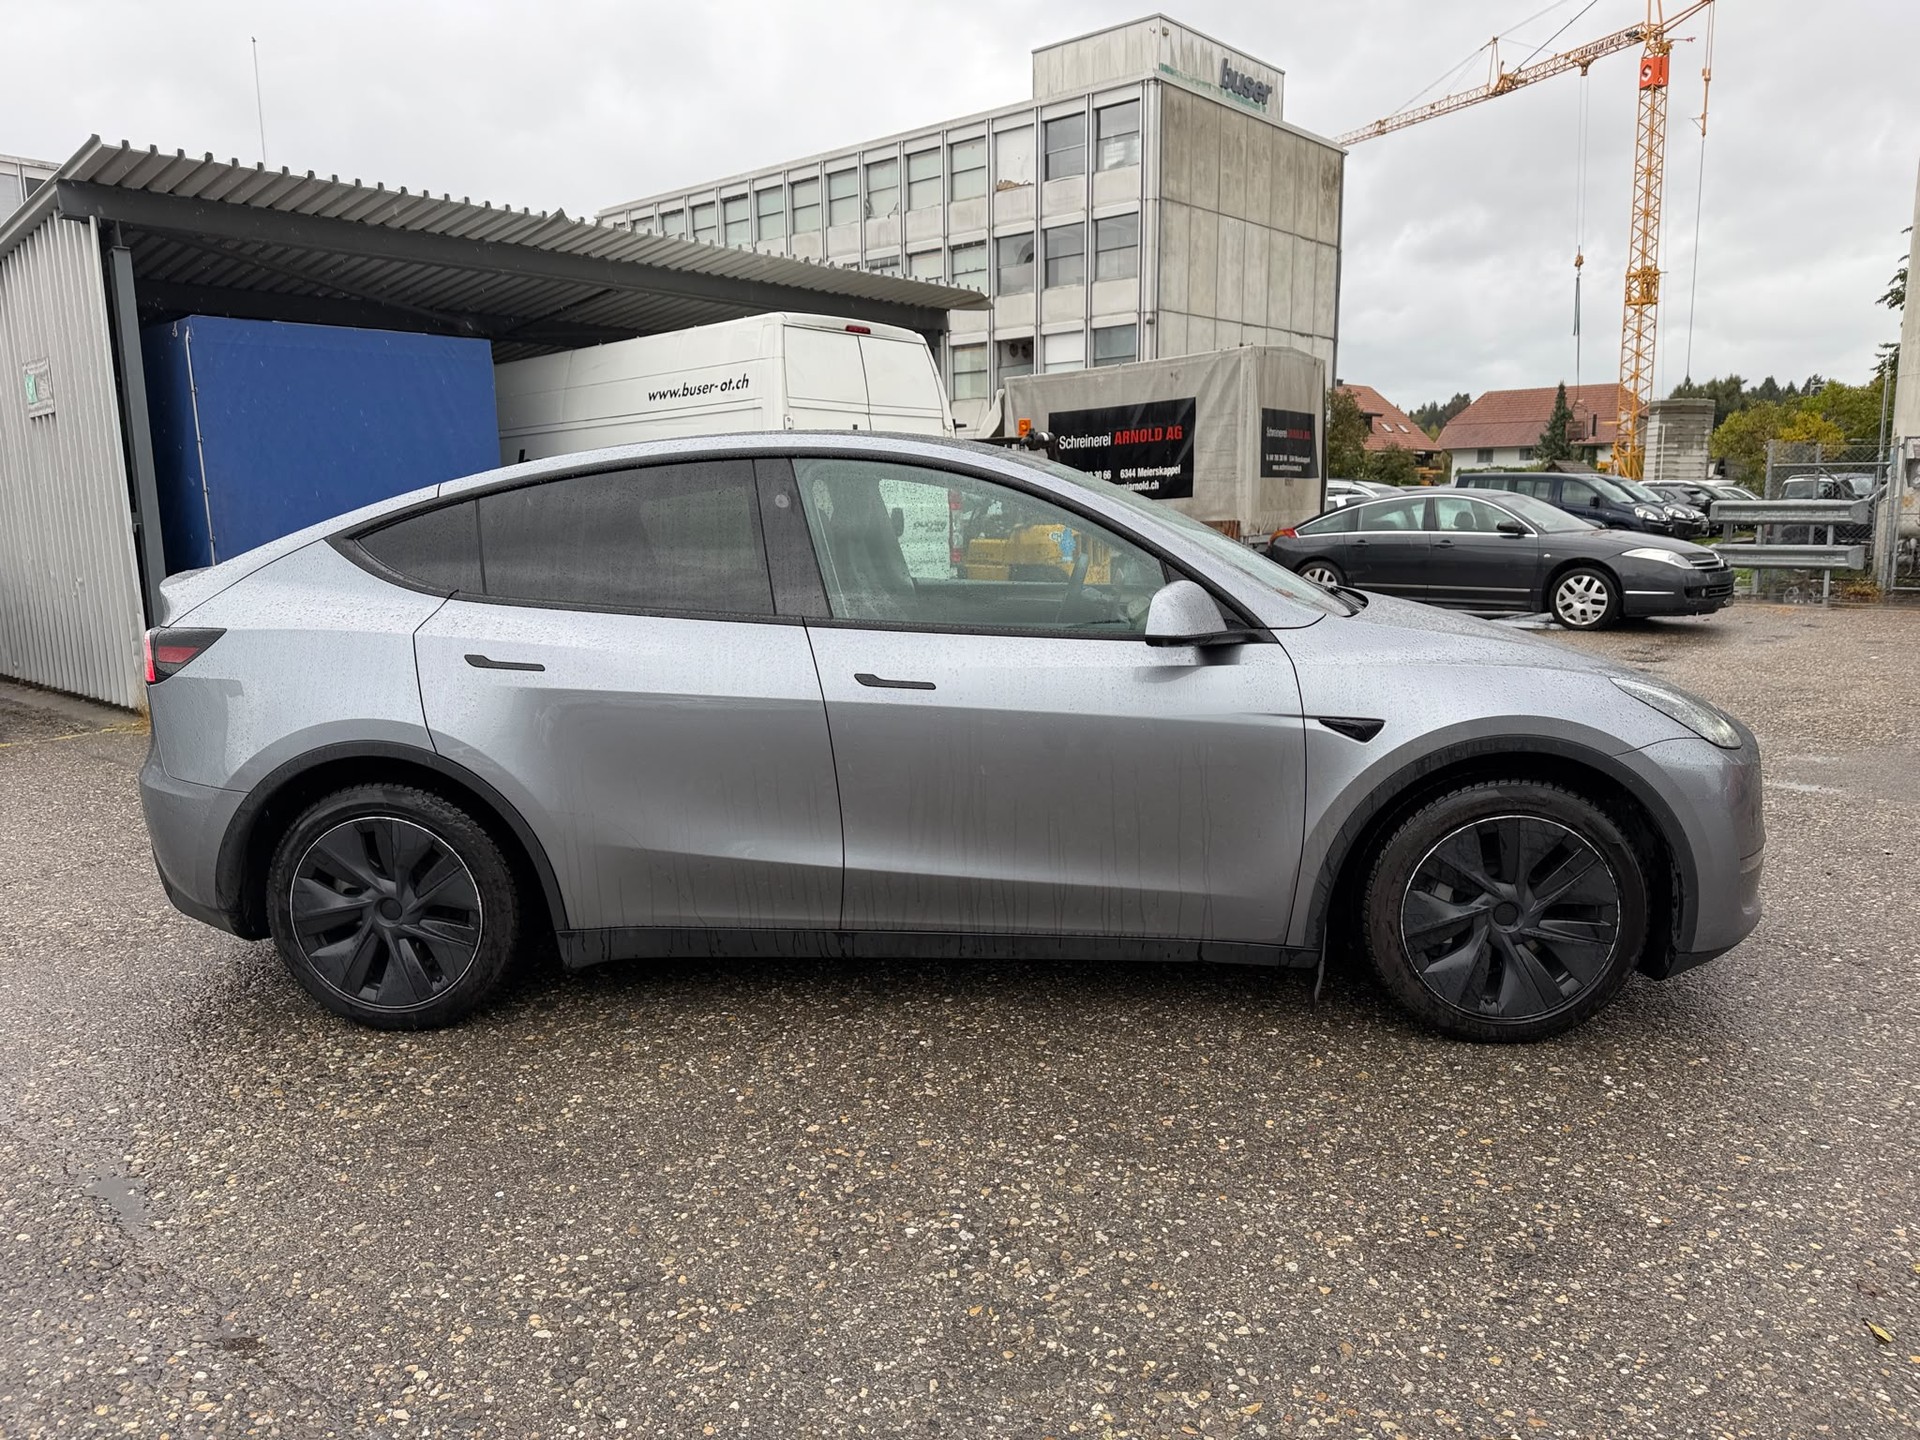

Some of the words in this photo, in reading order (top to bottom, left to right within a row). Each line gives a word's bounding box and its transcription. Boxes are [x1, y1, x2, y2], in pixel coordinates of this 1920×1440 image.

[1220, 57, 1272, 105] buser
[648, 373, 749, 401] www.buser-ot.ch
[1059, 432, 1111, 450] Schreinerei
[1114, 427, 1163, 445] ARNOLD
[1166, 425, 1183, 440] AG
[1103, 469, 1112, 480] 66
[1120, 469, 1136, 479] 6344
[1137, 464, 1181, 478] Meierskappel
